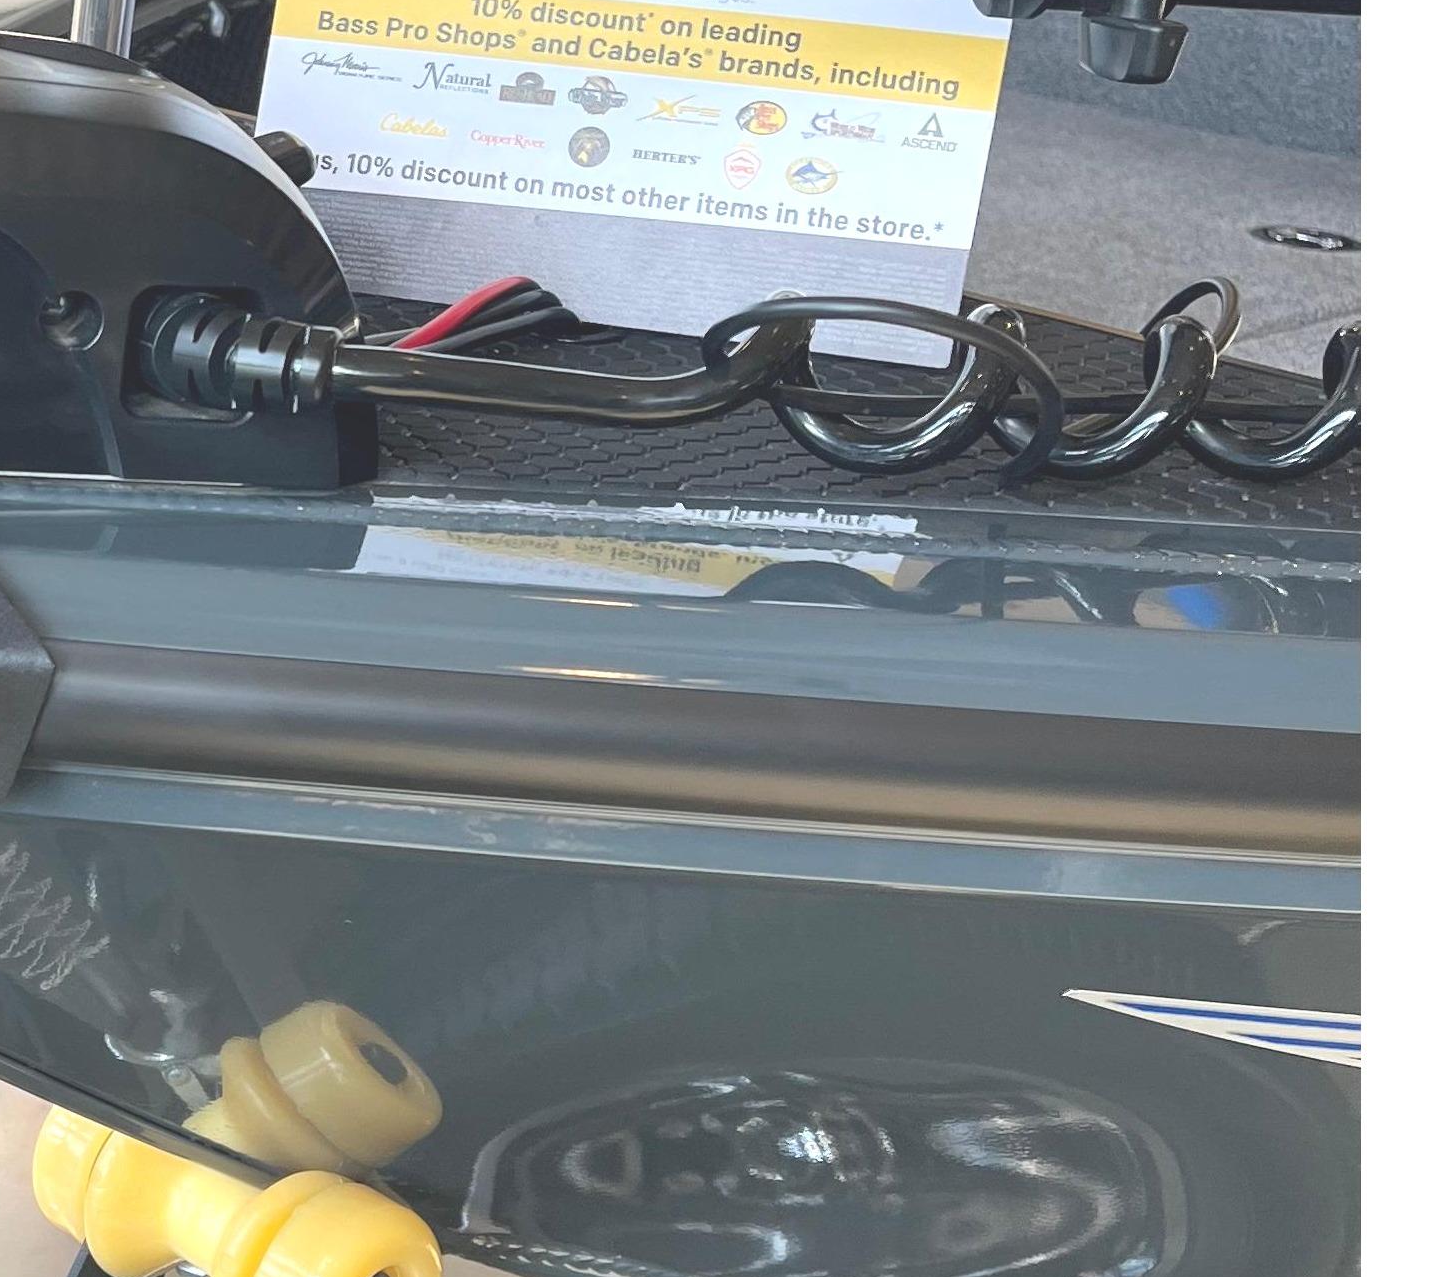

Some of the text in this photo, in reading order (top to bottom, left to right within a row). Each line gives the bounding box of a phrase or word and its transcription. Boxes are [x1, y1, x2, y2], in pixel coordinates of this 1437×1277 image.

[660, 19, 693, 37] on
[701, 17, 803, 52] leading
[318, 10, 379, 36] Bass
[386, 17, 429, 42] Pro
[532, 35, 581, 57] and
[719, 50, 821, 86] brands,
[830, 62, 960, 101] including
[412, 62, 492, 91] Natural
[901, 135, 958, 153] ASCEND
[347, 153, 395, 179] 10%
[401, 159, 507, 191] discount
[514, 176, 544, 196] on
[551, 179, 615, 204] most
[622, 186, 691, 212] other
[696, 191, 769, 222] items
[776, 203, 799, 225] in
[808, 207, 849, 231] the
